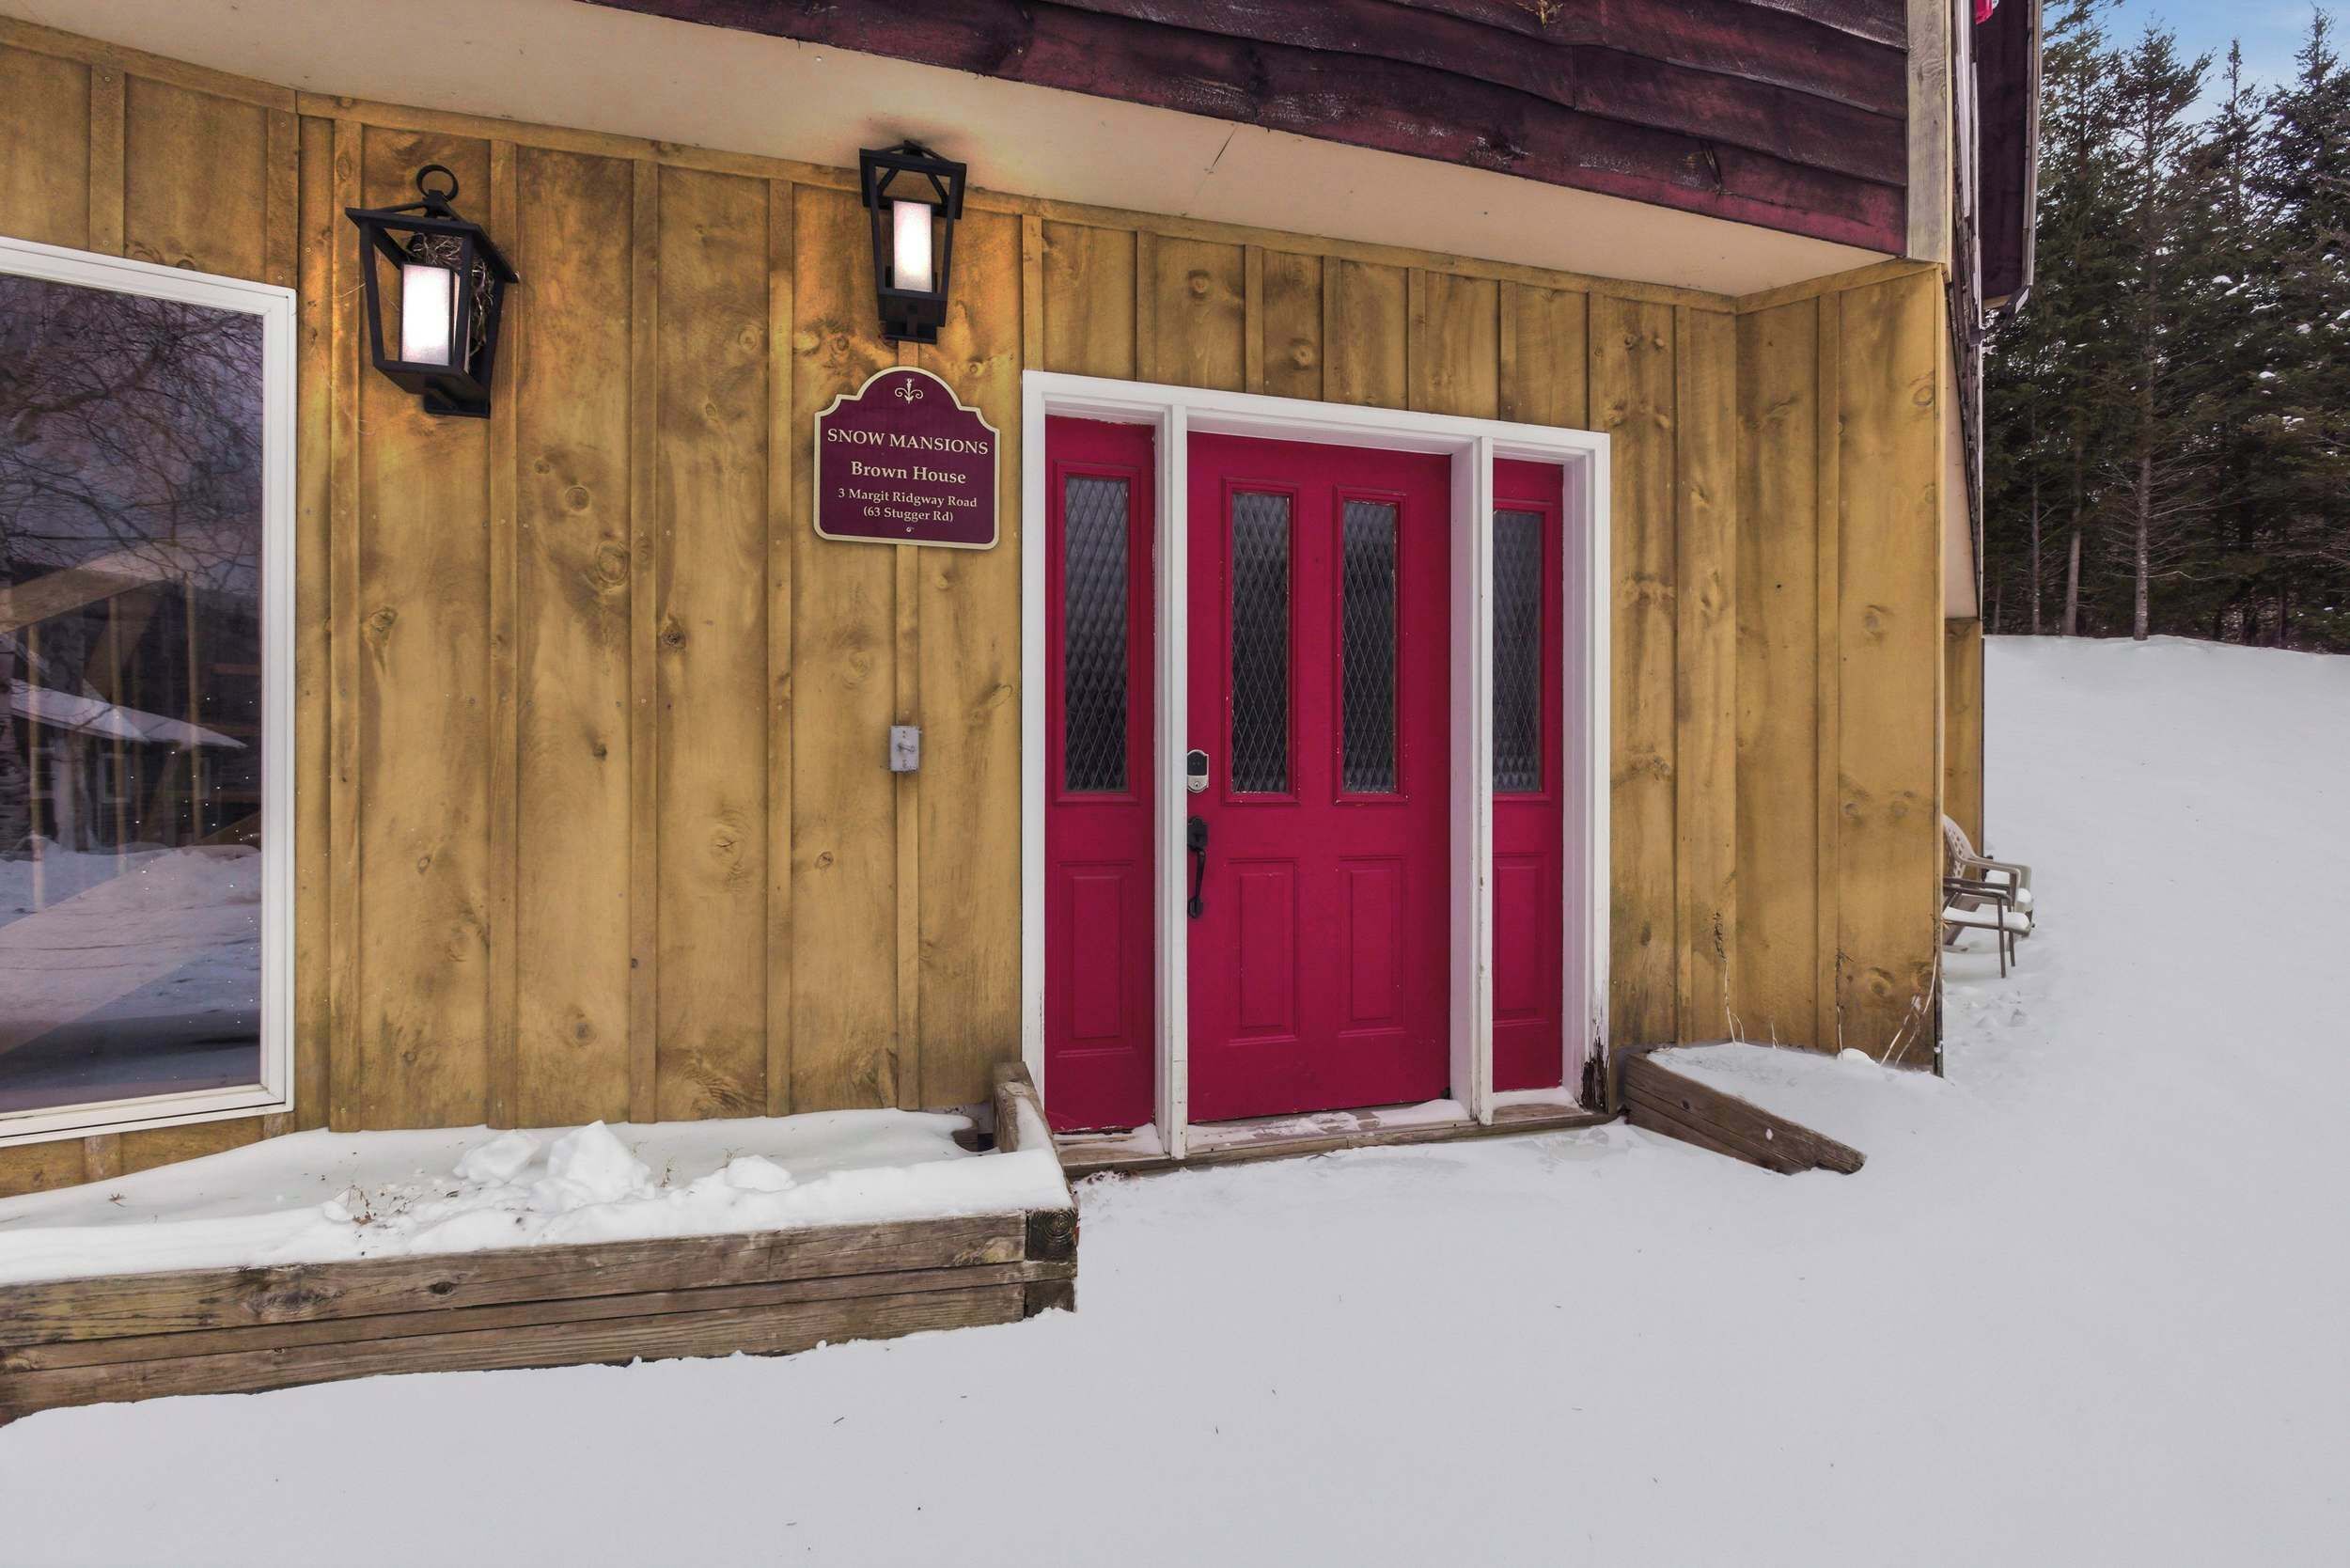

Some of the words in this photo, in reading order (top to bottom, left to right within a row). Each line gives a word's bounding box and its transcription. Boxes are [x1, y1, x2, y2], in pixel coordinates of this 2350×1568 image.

[827, 429, 885, 446] SNOW
[889, 434, 988, 455] MANSIONS
[851, 461, 907, 479] Brown
[913, 466, 966, 484] House
[838, 489, 845, 498] 3
[849, 489, 889, 504] Margit
[893, 492, 945, 508] Ridgway
[948, 496, 978, 508] Road
[864, 506, 881, 517] (63
[884, 508, 930, 523] Stugger
[933, 511, 953, 522] Rd)
